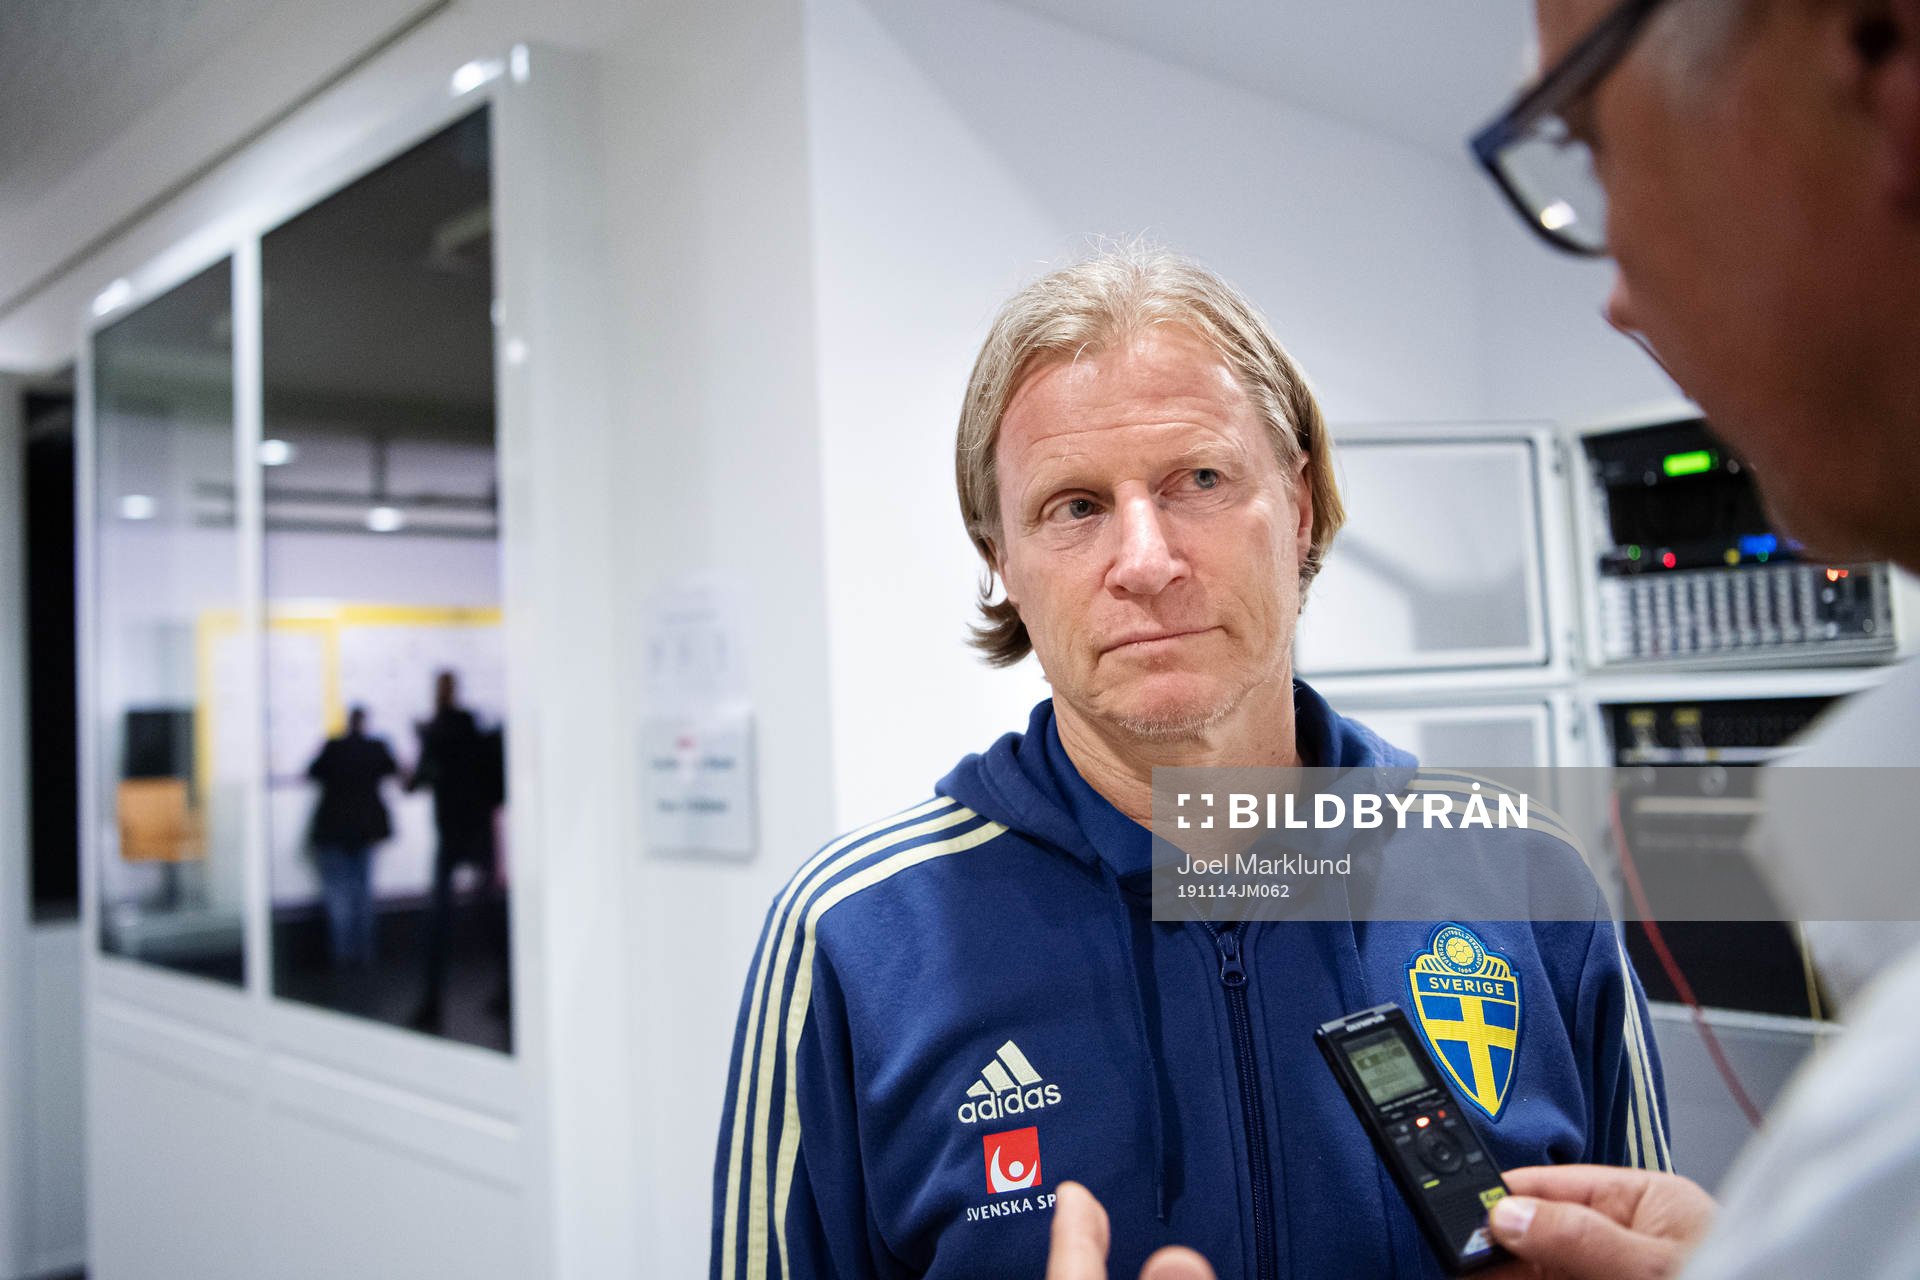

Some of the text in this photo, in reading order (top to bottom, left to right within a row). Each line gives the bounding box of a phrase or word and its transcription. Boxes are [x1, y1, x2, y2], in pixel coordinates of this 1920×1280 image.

[1429, 976, 1505, 996] SVERIGE
[957, 1084, 1062, 1124] adidas
[967, 1193, 1057, 1222] SVENSKA SP
